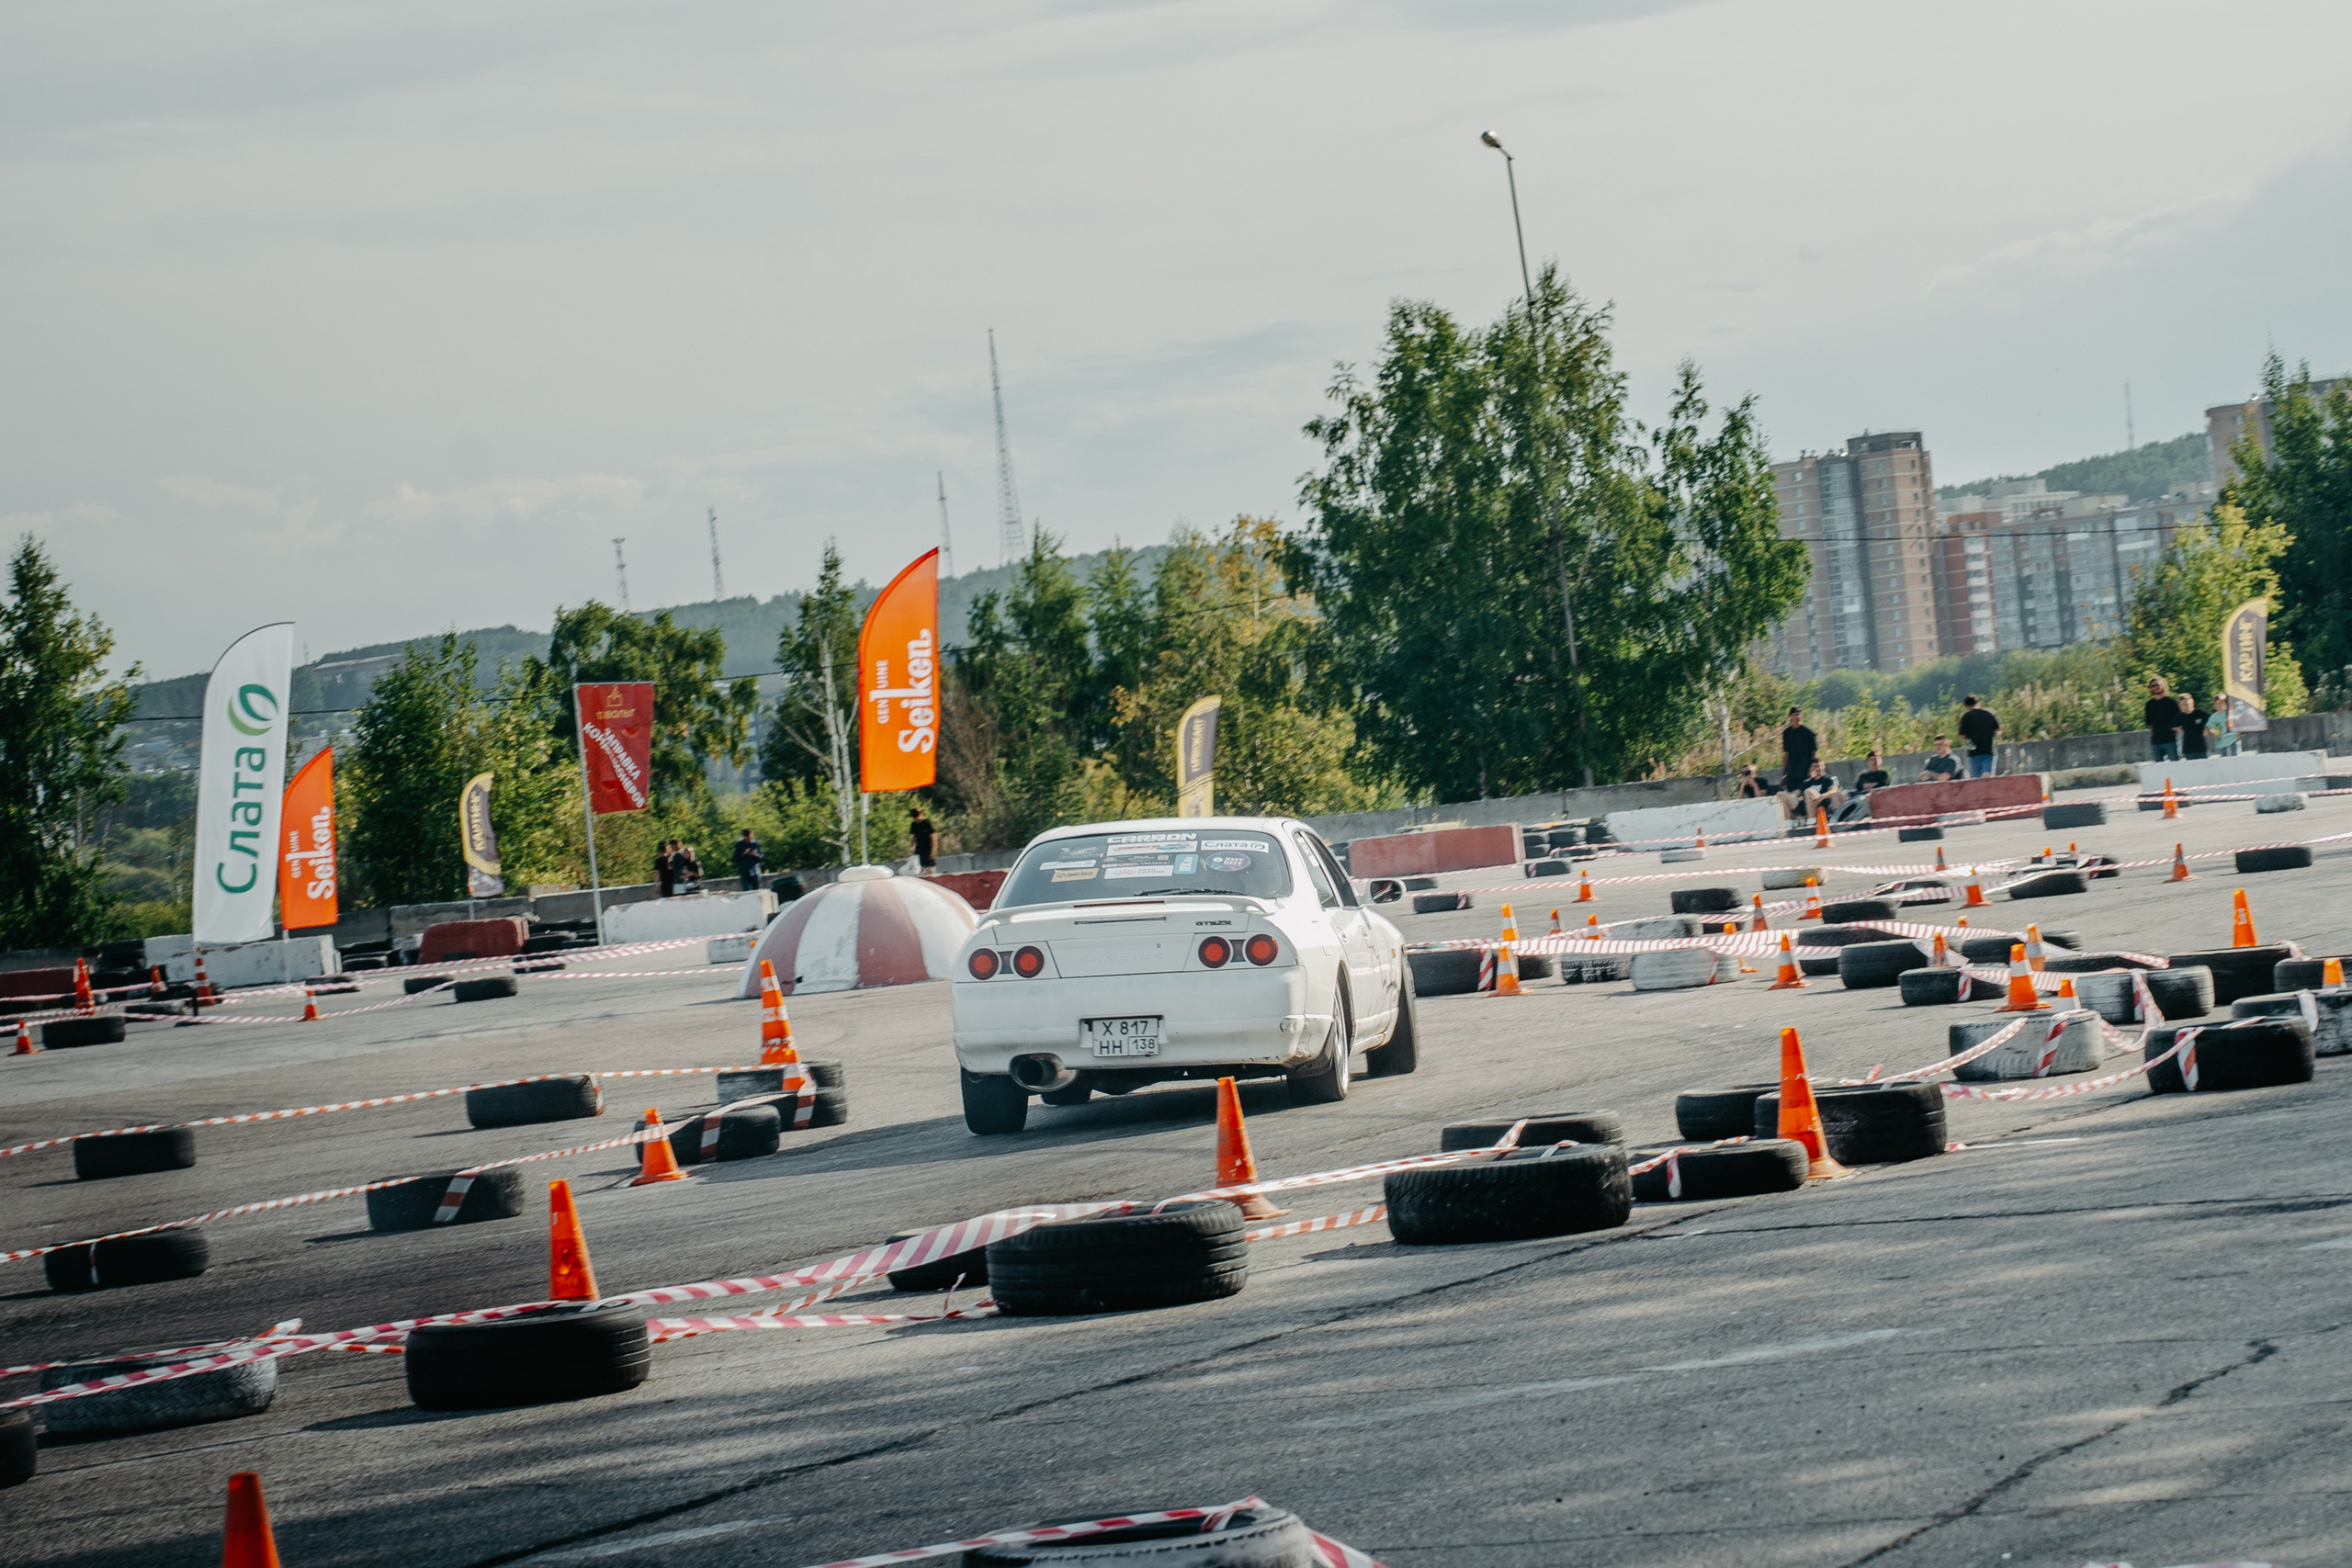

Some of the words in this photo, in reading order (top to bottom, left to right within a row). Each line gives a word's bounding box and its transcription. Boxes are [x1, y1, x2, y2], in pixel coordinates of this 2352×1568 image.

[2238, 616, 2254, 682] КАРТИНГ
[876, 659, 889, 724] GENUINE
[605, 727, 641, 780] ЗАПРАВКА
[216, 747, 266, 894] Слата
[470, 790, 485, 852] КАРТИНГ
[290, 829, 301, 879] GENUINE
[1120, 1021, 1148, 1035] 817
[1132, 1038, 1156, 1050] 138
